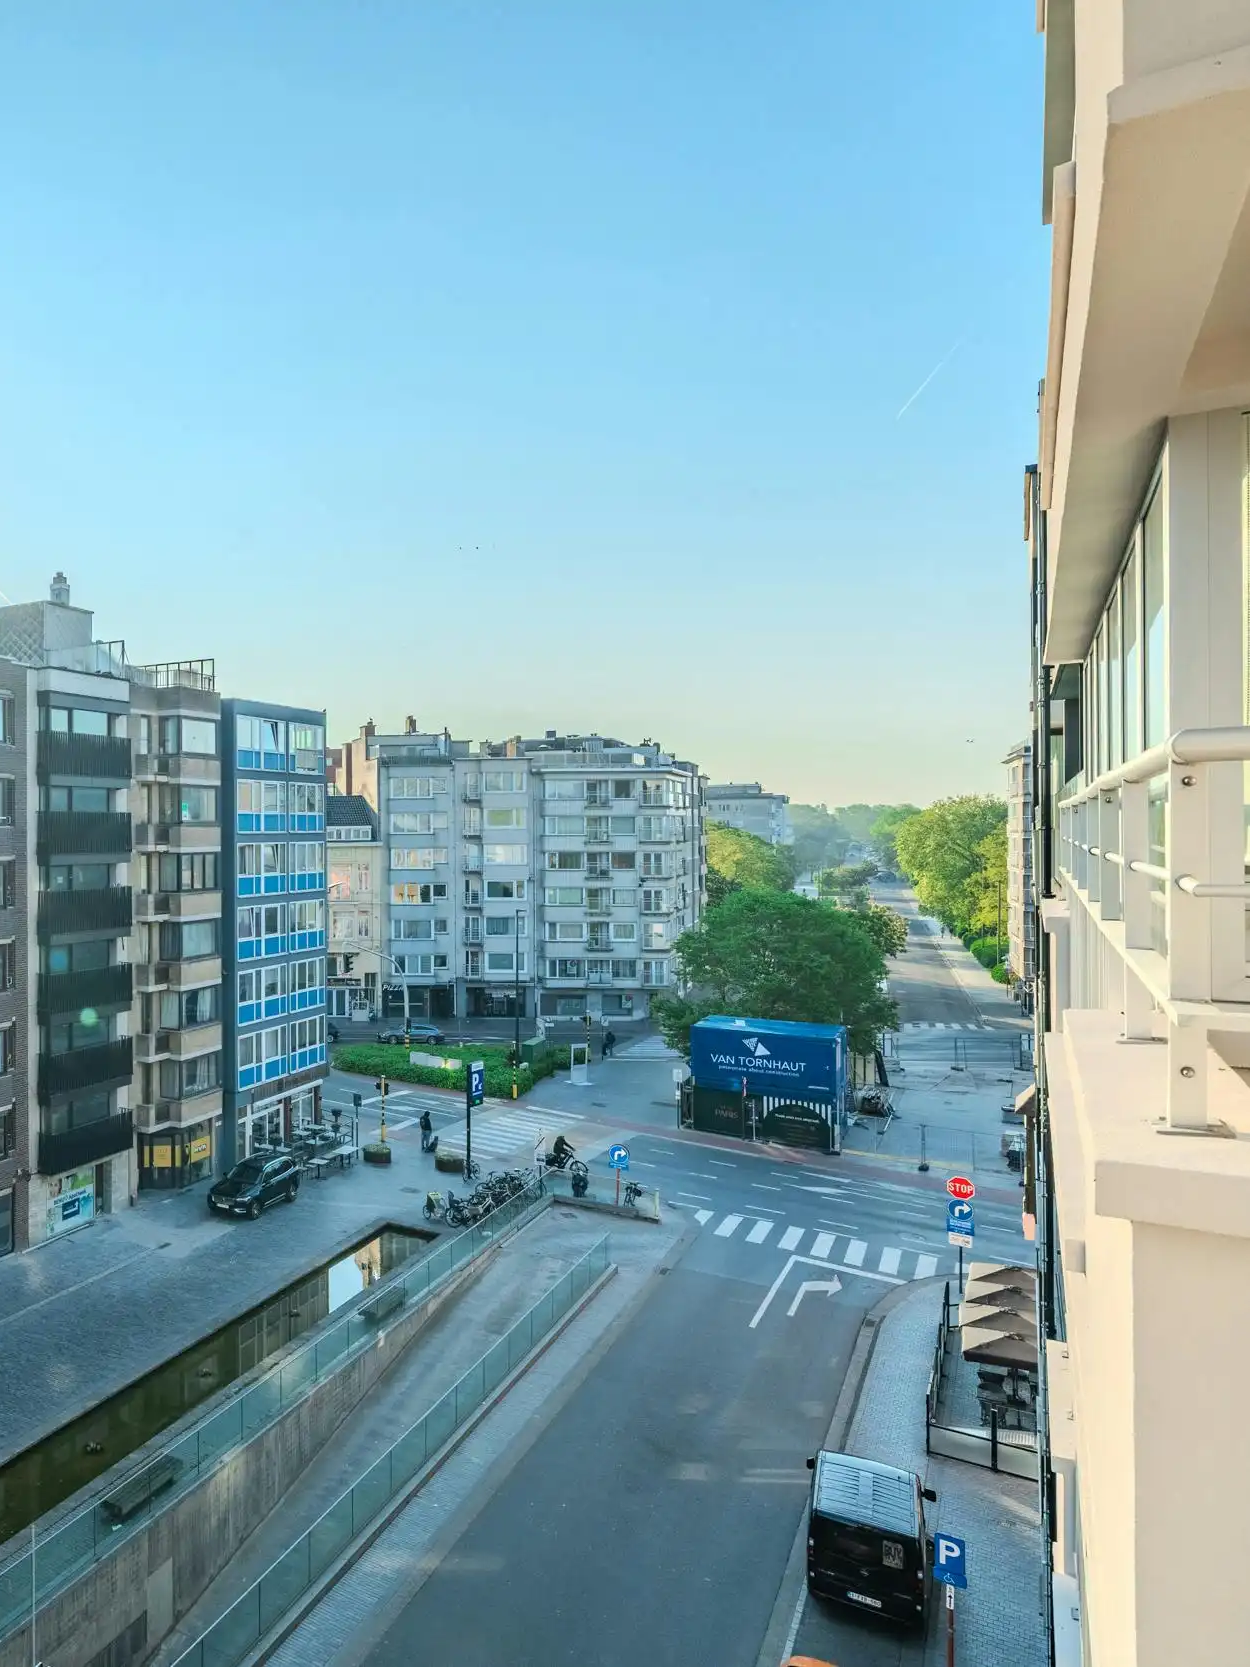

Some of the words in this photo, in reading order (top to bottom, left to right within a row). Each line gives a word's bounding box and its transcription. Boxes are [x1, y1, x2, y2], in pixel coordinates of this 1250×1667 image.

[710, 1053, 735, 1065] VAN
[738, 1056, 807, 1072] TORNHAUT
[472, 1073, 479, 1092] P
[949, 1182, 973, 1194] STOP
[939, 1539, 961, 1565] P
